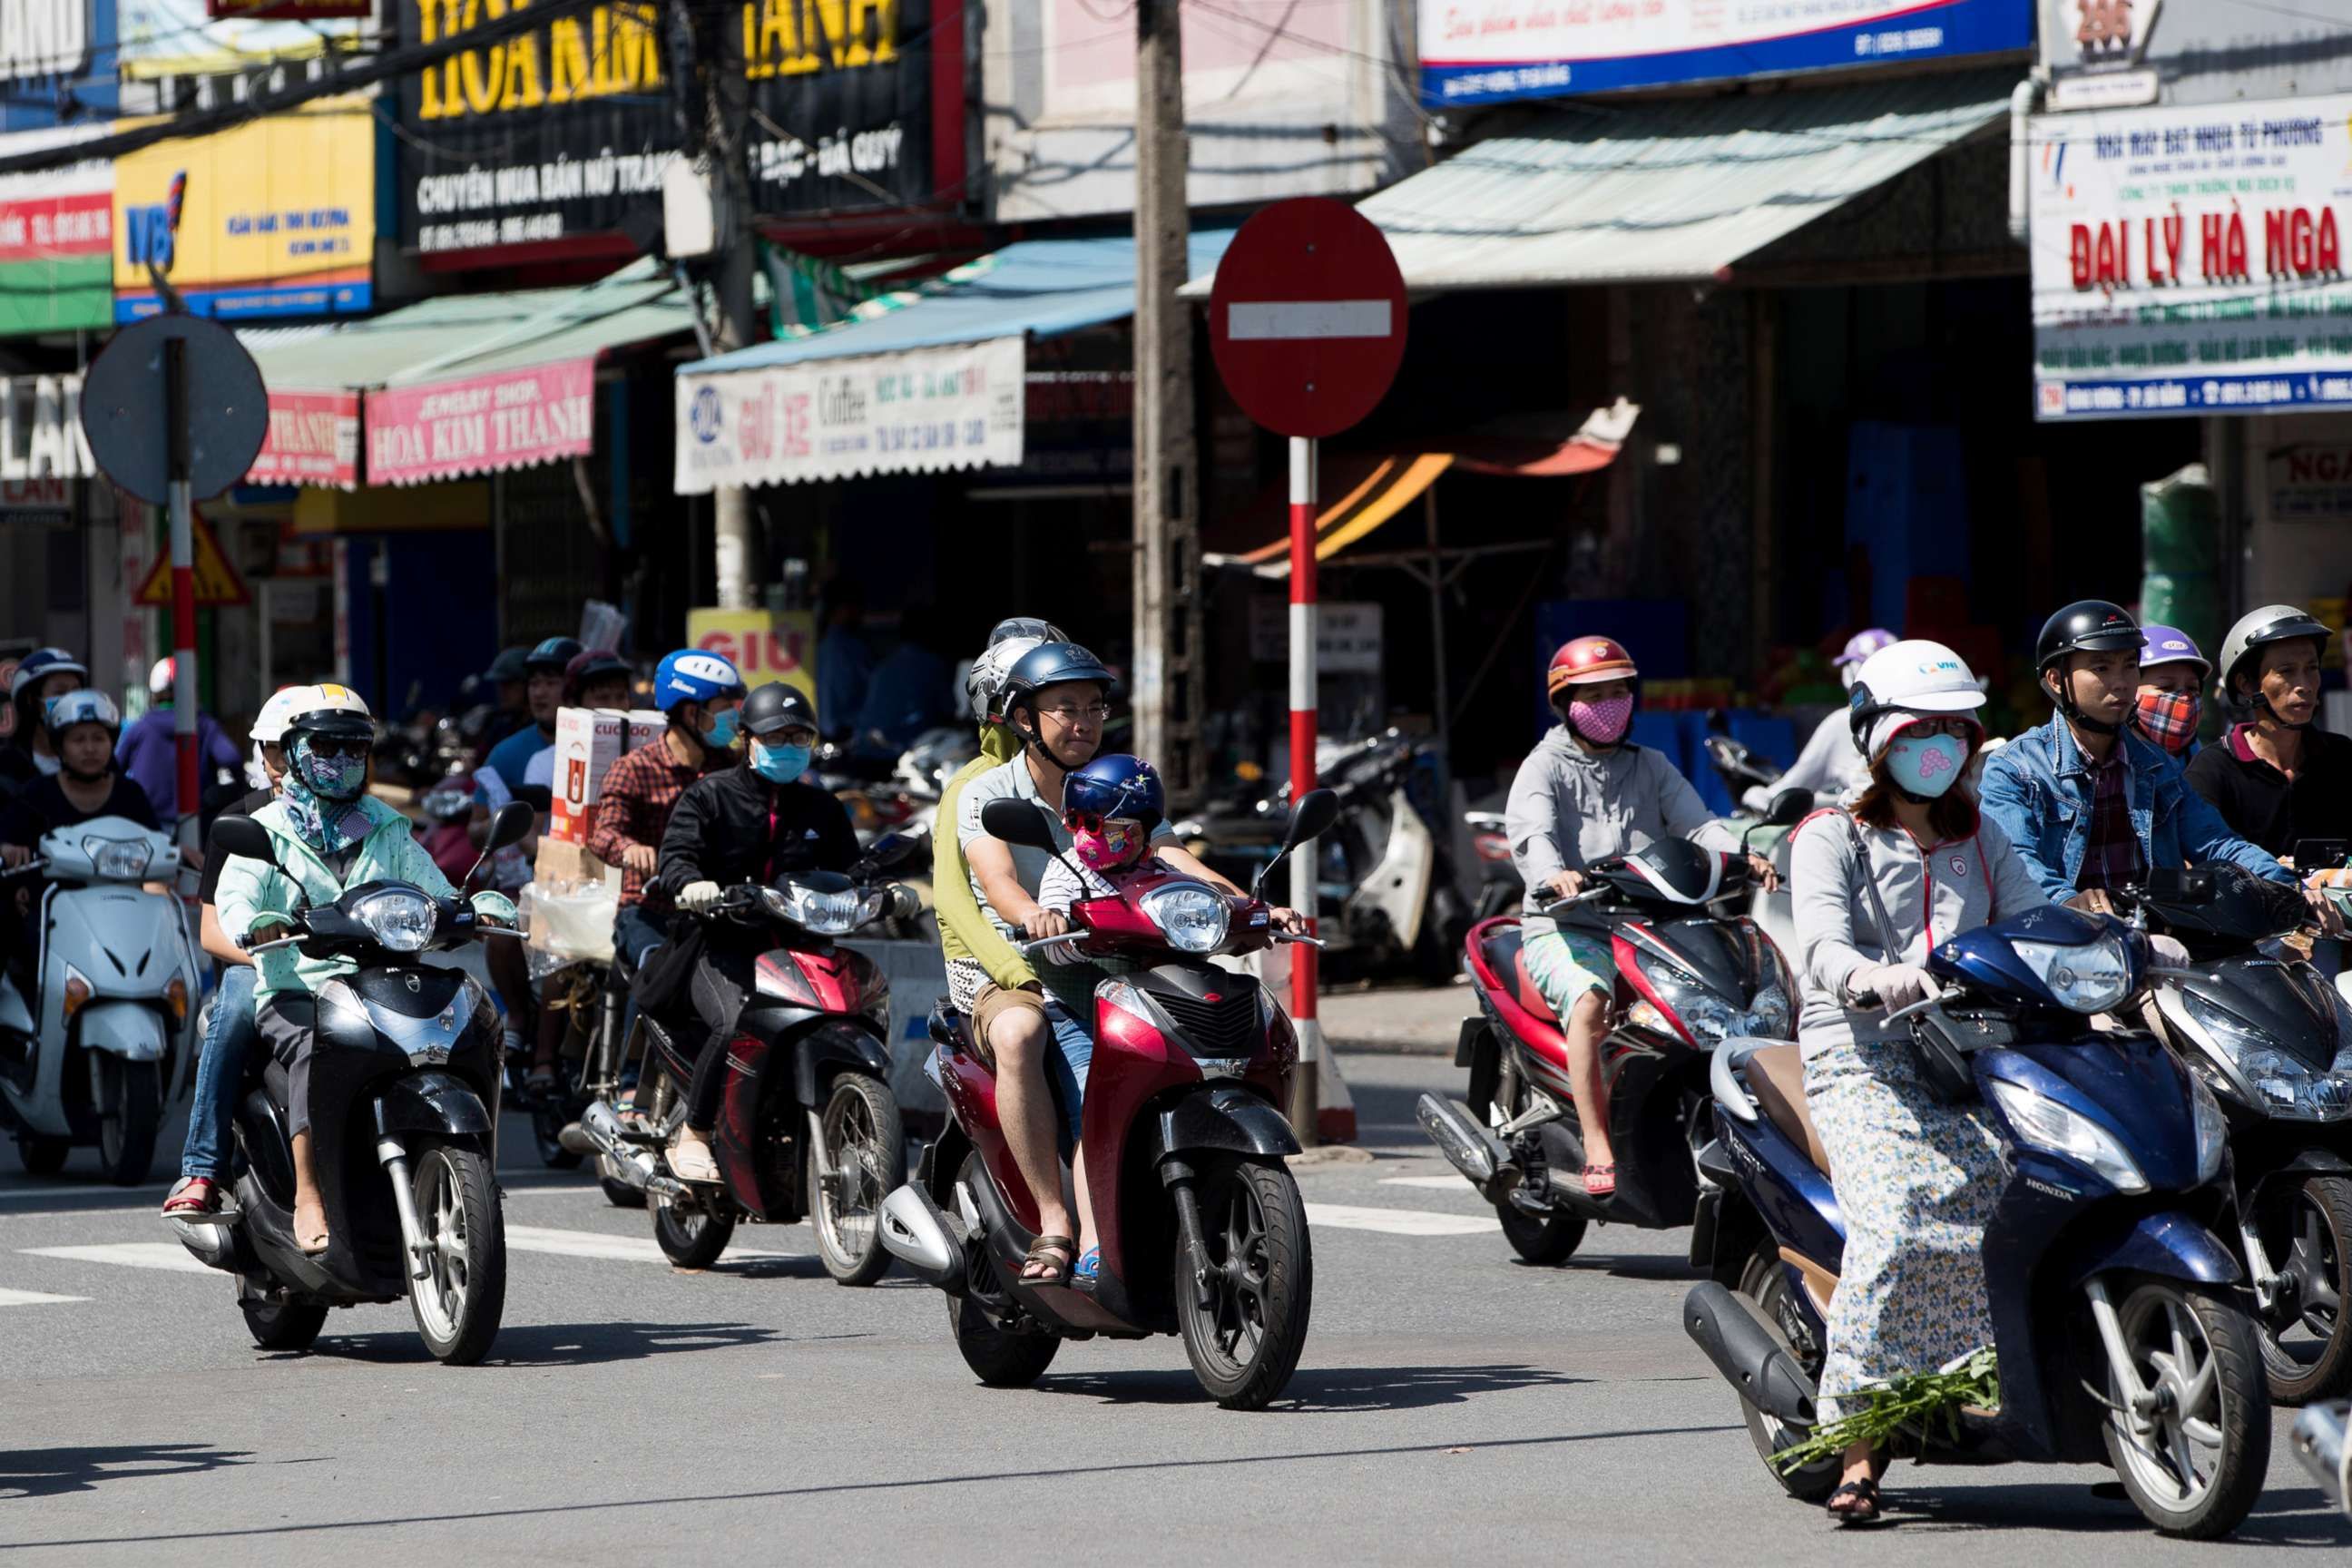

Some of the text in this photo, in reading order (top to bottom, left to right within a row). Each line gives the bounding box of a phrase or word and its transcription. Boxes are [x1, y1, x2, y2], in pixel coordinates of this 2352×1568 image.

[417, 163, 495, 214] CHUYÊN
[496, 165, 539, 206] MUA
[541, 152, 583, 201] BÁN
[2201, 197, 2250, 283] HÀ
[2266, 206, 2341, 281] NGA
[372, 420, 427, 470] HOA
[432, 415, 485, 461] KIM
[2026, 1178, 2073, 1201] HONDA
